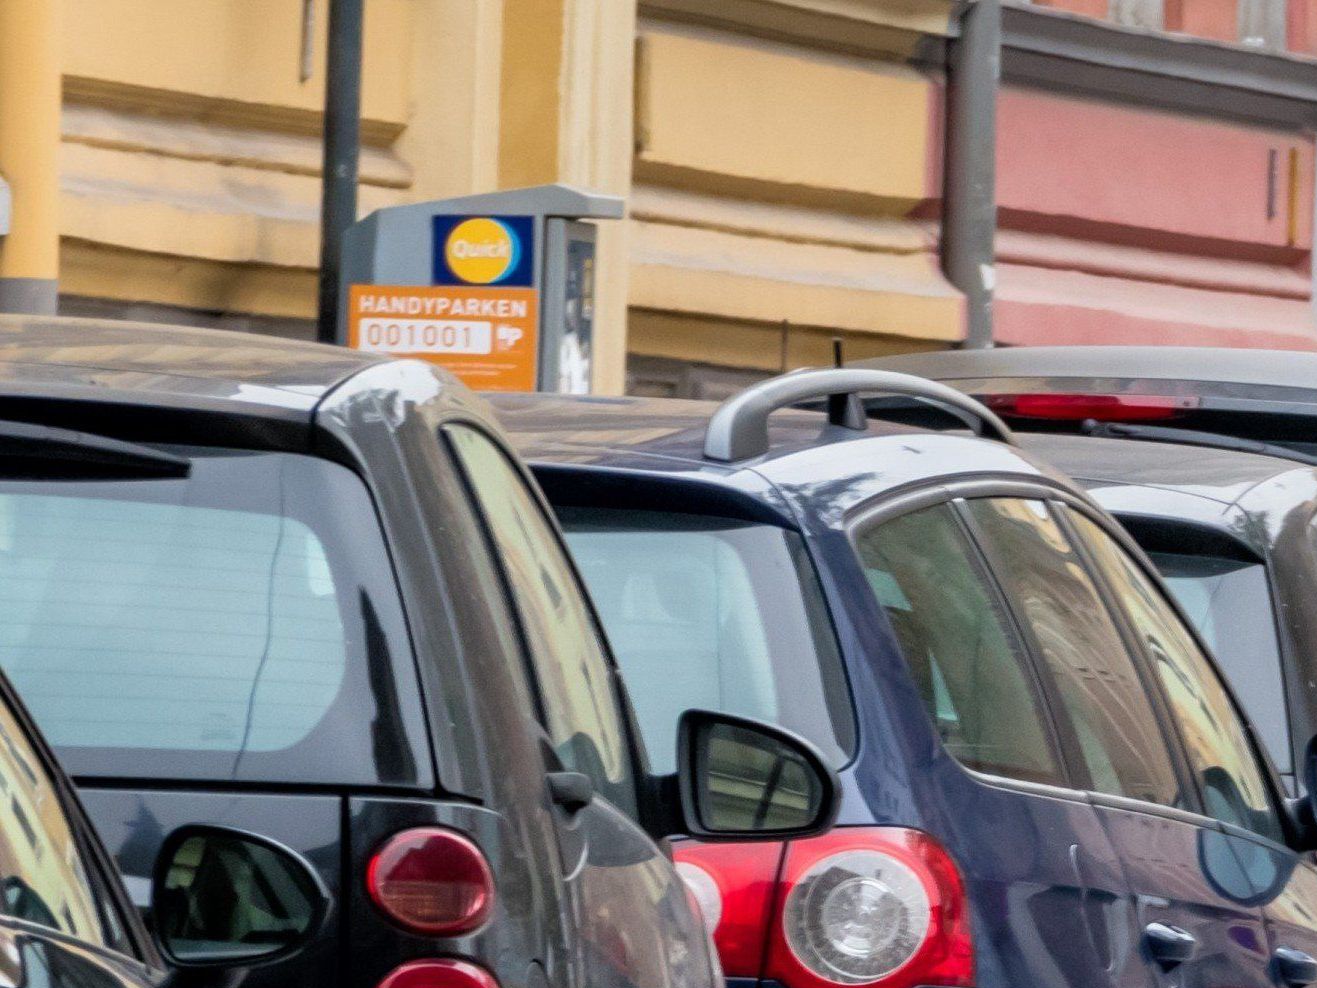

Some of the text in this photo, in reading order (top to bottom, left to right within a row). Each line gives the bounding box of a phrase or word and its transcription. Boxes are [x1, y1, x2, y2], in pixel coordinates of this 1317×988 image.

[454, 239, 510, 258] Quick
[360, 296, 527, 317] HANDYPARKEN
[367, 324, 471, 347] 001001
